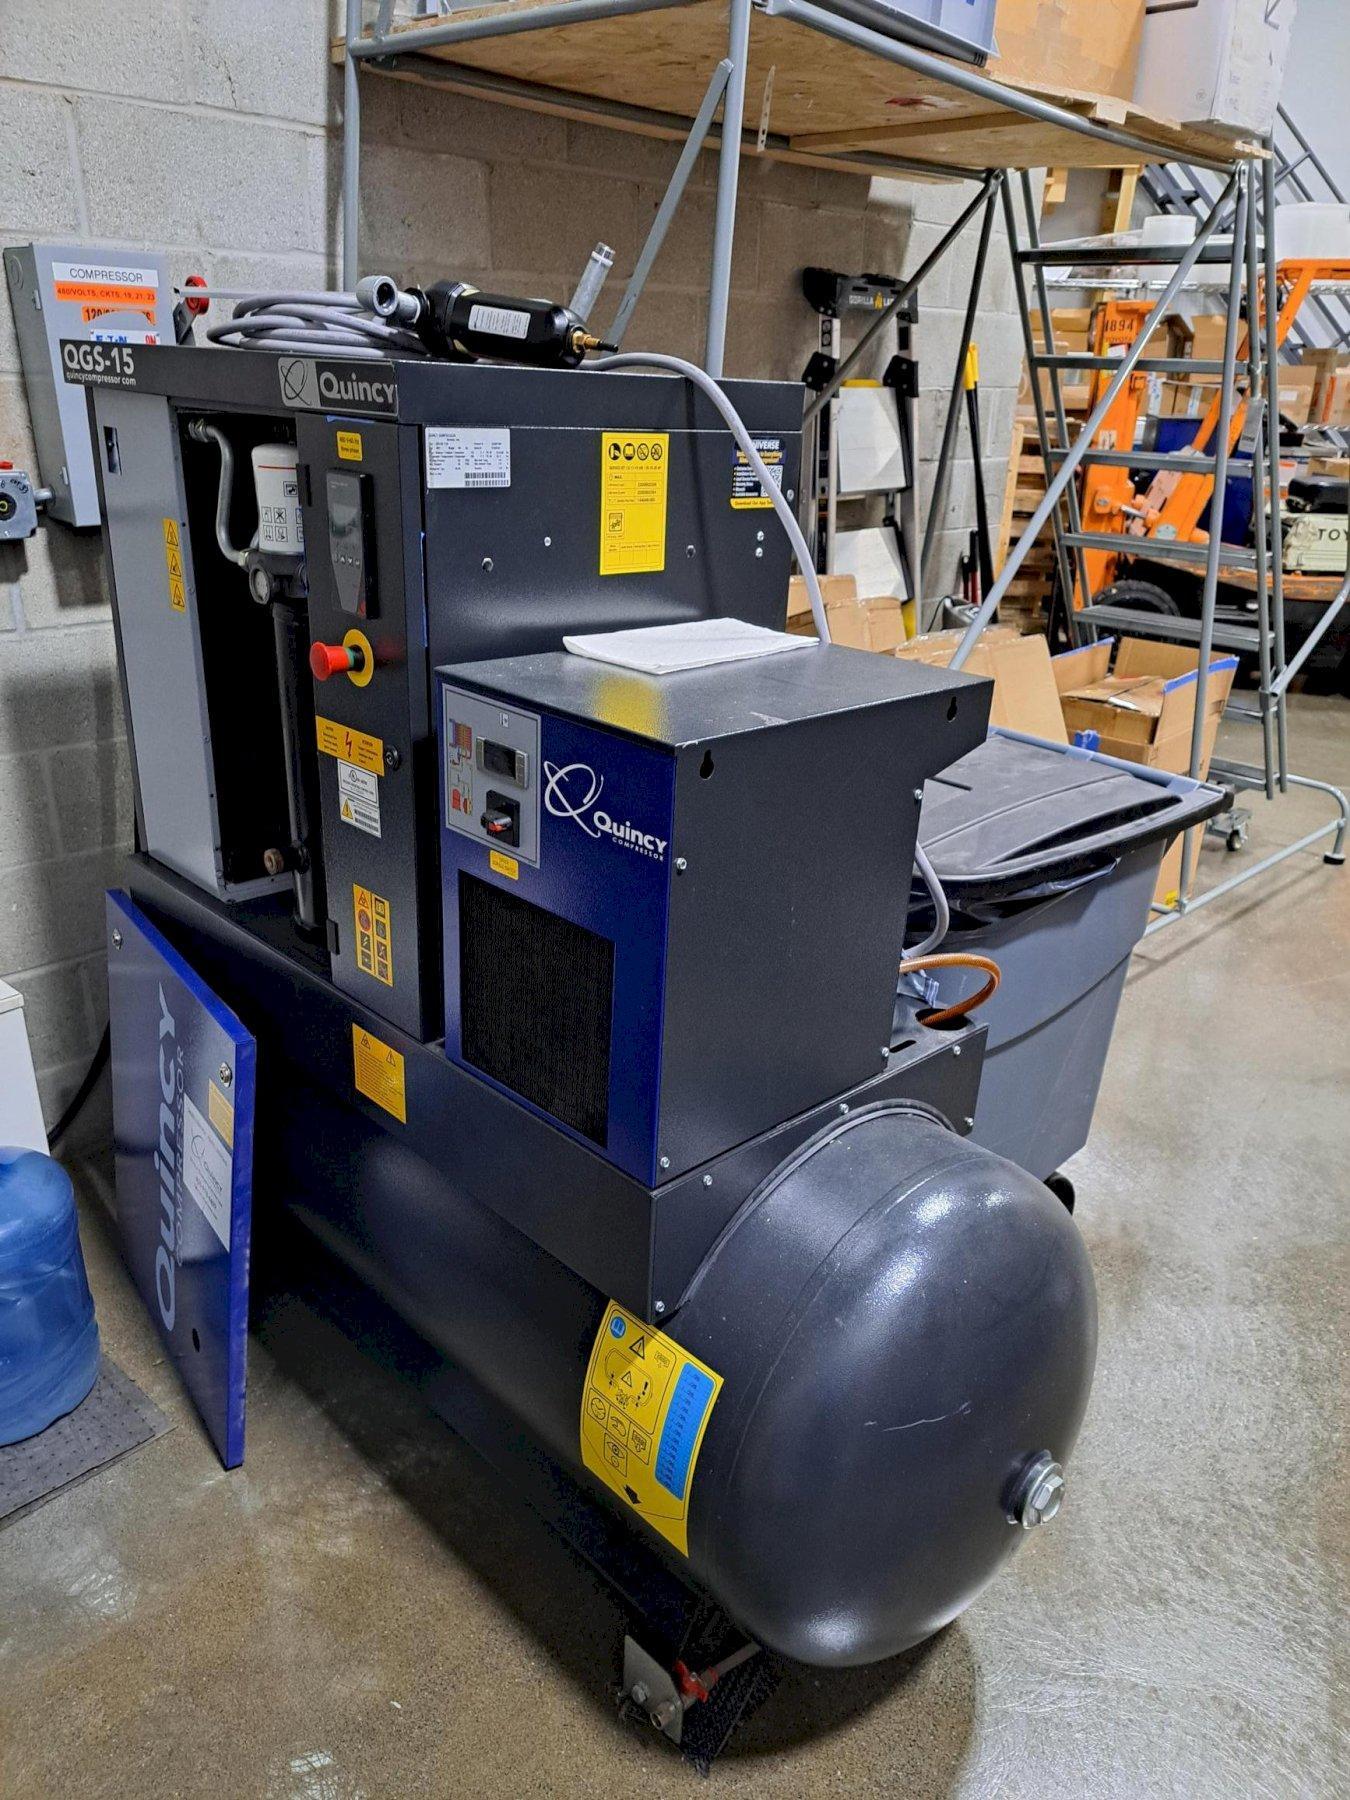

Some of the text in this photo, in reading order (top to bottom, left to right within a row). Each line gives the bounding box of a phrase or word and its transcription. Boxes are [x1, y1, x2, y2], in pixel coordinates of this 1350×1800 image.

[69, 268, 143, 282] COMPRESSOR
[64, 343, 134, 375] QGS-15
[593, 811, 667, 853] Quincy
[612, 836, 664, 862] COMPRESSOR
[174, 1046, 185, 1267] COMPRESSOR
